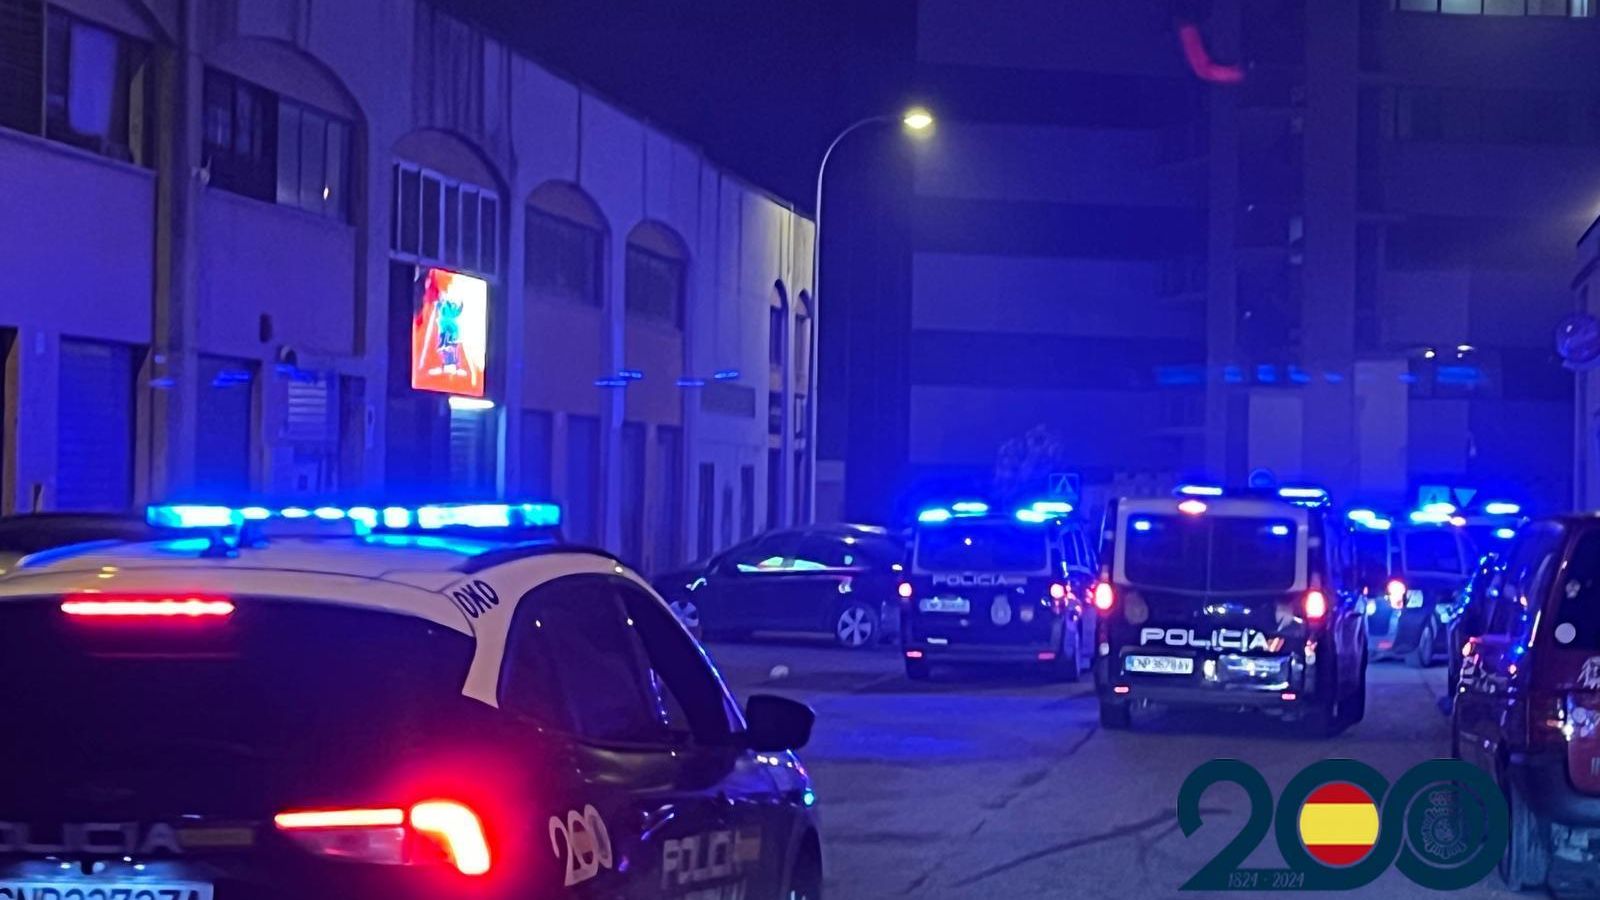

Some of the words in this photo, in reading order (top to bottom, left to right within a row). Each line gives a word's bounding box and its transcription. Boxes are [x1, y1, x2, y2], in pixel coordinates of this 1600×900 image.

[932, 574, 1006, 586] POLICIA
[1140, 627, 1269, 652] POLICIA
[549, 804, 612, 886] 200
